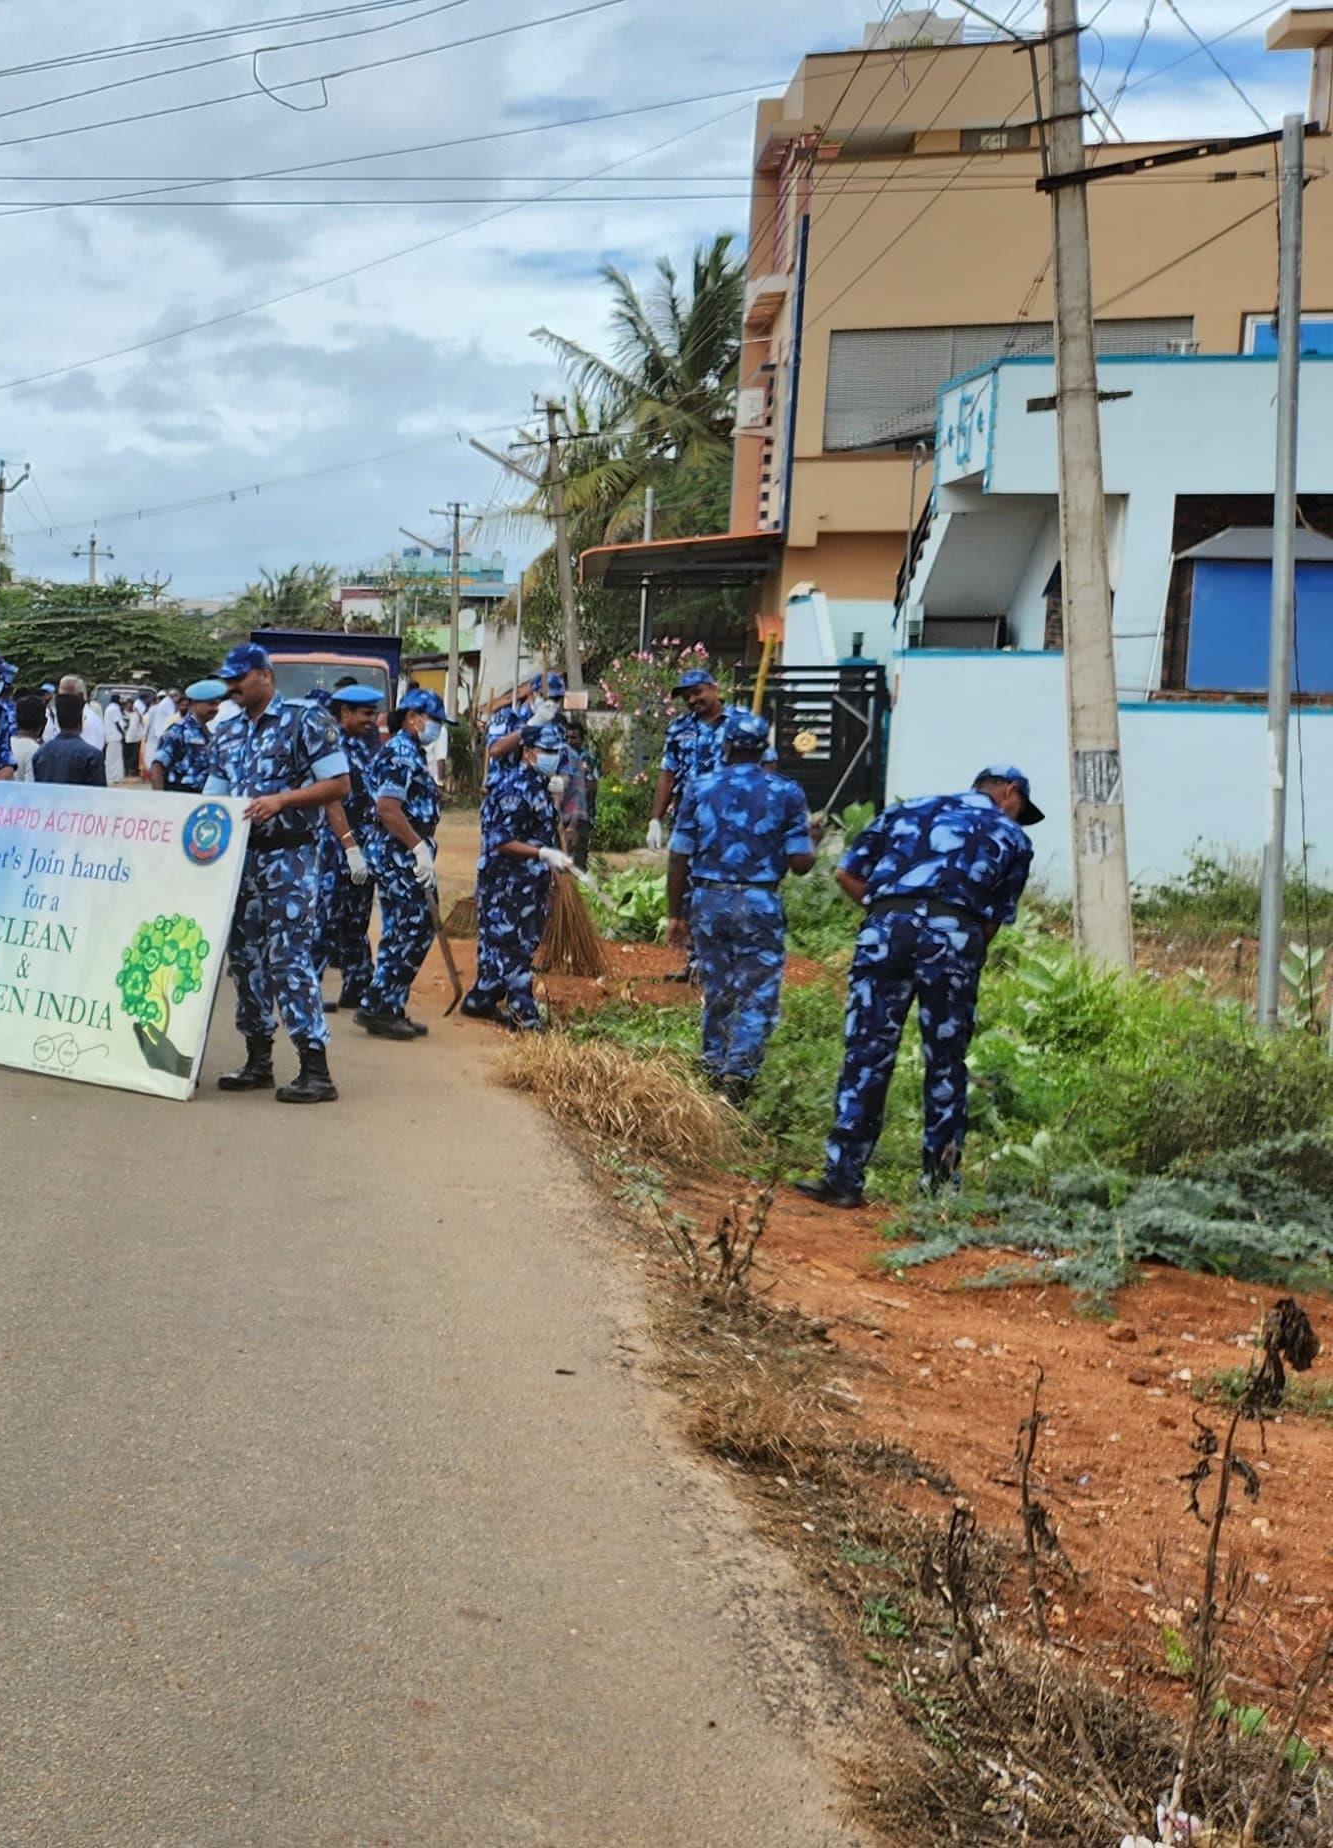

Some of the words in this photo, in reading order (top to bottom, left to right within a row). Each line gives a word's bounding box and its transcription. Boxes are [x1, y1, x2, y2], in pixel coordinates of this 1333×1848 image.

[43, 809, 109, 837] ACTION
[111, 816, 174, 843] FORCE
[23, 847, 65, 880] Join
[70, 851, 132, 884] hands
[22, 884, 46, 910] for
[50, 895, 60, 912] a
[16, 952, 31, 980] &
[34, 990, 113, 1031] INDIA
